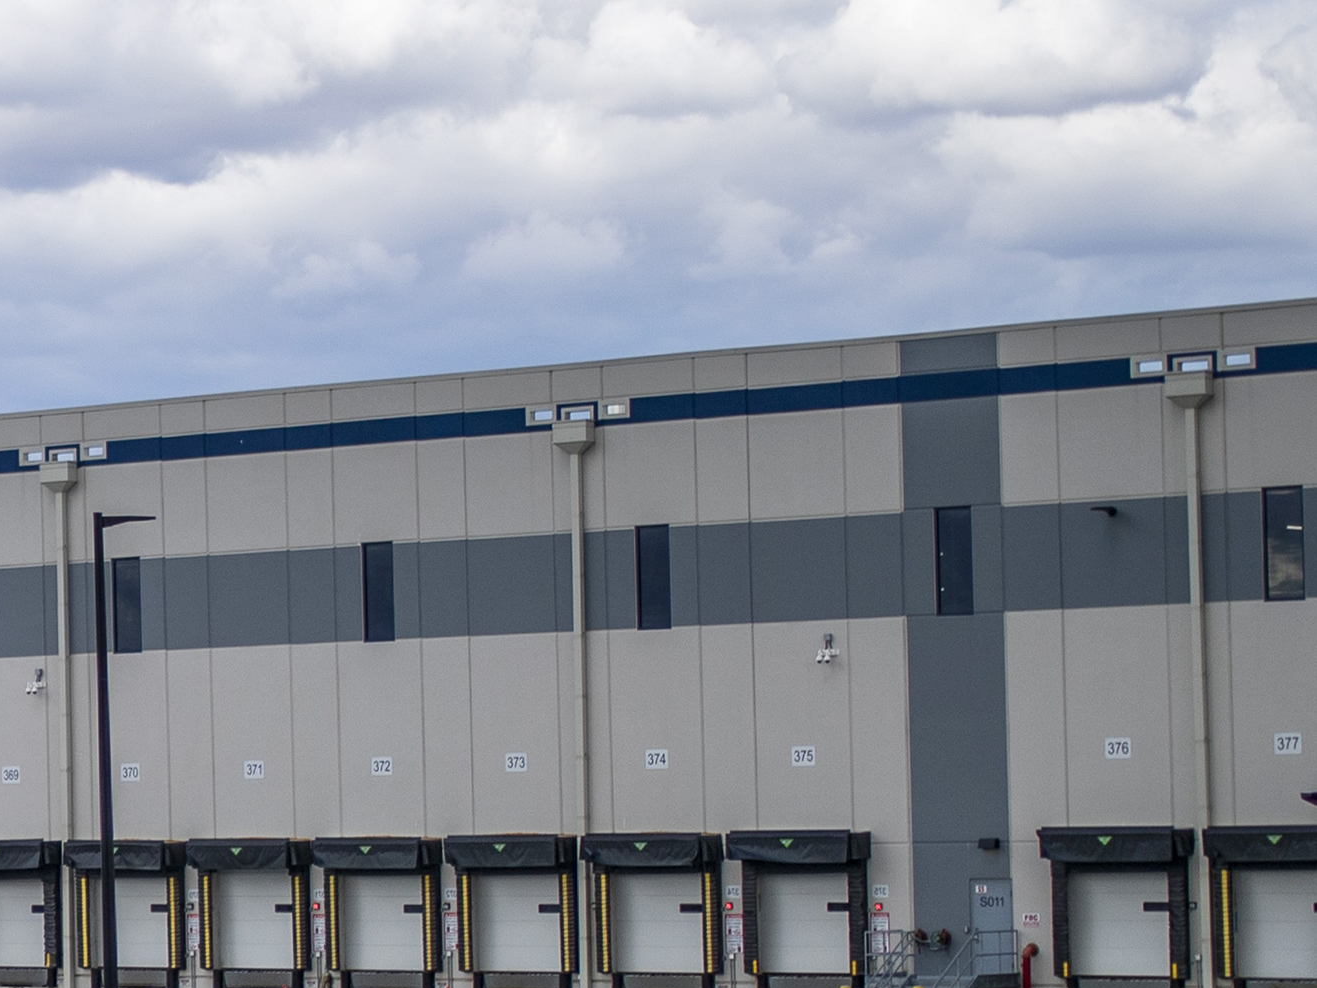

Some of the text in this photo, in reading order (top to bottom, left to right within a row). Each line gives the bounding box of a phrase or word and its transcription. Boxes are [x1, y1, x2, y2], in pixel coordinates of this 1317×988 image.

[1107, 741, 1130, 756] 376
[1277, 736, 1299, 751] 377
[507, 756, 526, 769] 373
[647, 753, 666, 766] 374
[793, 749, 814, 763] 375
[122, 767, 139, 779] 370
[246, 763, 263, 776] 371
[373, 760, 391, 773] 372
[3, 769, 19, 781] 369
[980, 896, 1005, 908] S011
